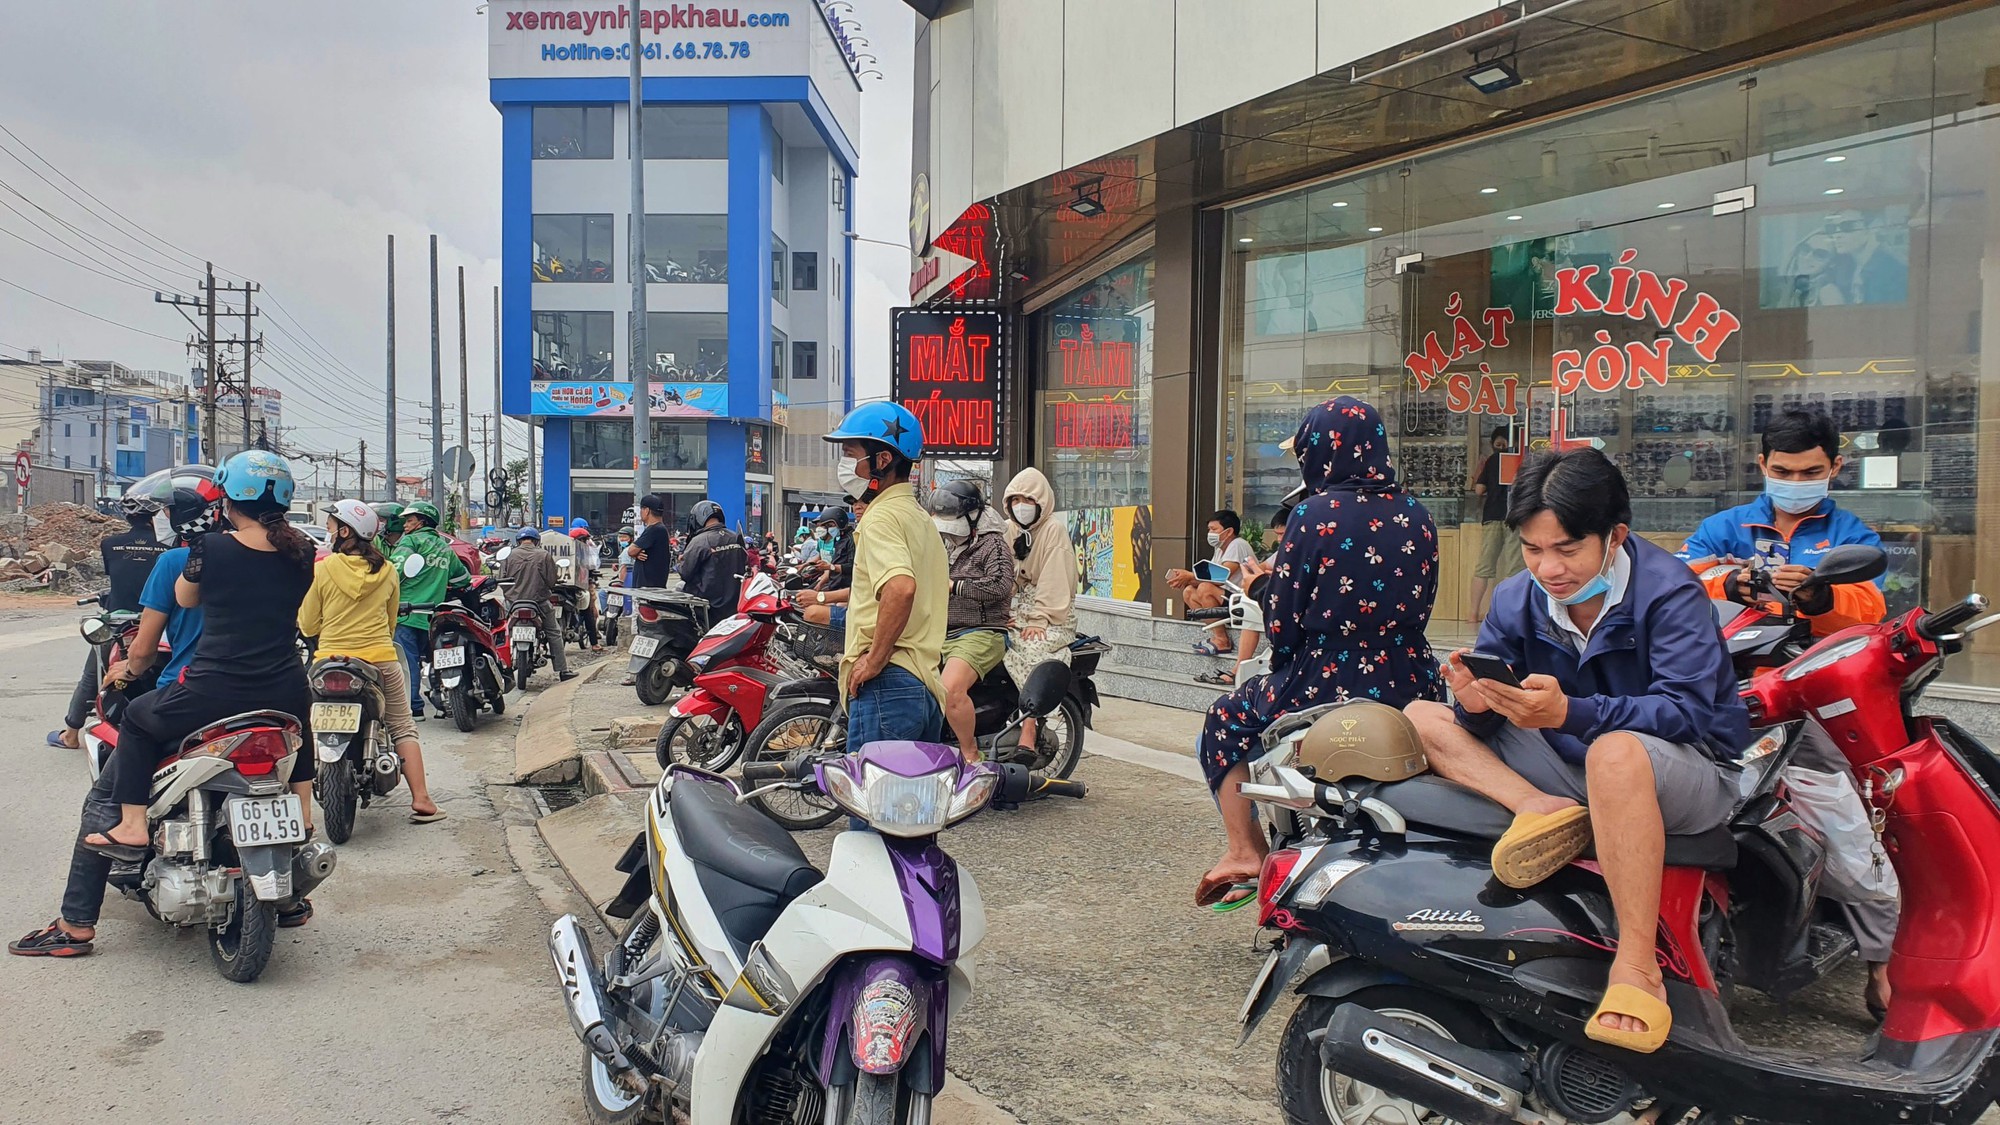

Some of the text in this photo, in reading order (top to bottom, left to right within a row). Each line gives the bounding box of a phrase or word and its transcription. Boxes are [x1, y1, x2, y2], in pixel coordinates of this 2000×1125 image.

[506, 4, 790, 36] xemaynhapkhau.com
[1553, 248, 1741, 364] KÍNH
[909, 318, 991, 382] MẮT
[1404, 291, 1515, 393] MẮT
[1552, 330, 1674, 397] GÒN
[1445, 362, 1520, 416] SÀI
[904, 390, 992, 446] KÍNH
[426, 553, 449, 570] Gra
[319, 704, 353, 718] 36-B4
[237, 819, 300, 842] 084.59
[241, 799, 289, 821] 66-G1
[1405, 908, 1483, 923] Attila
